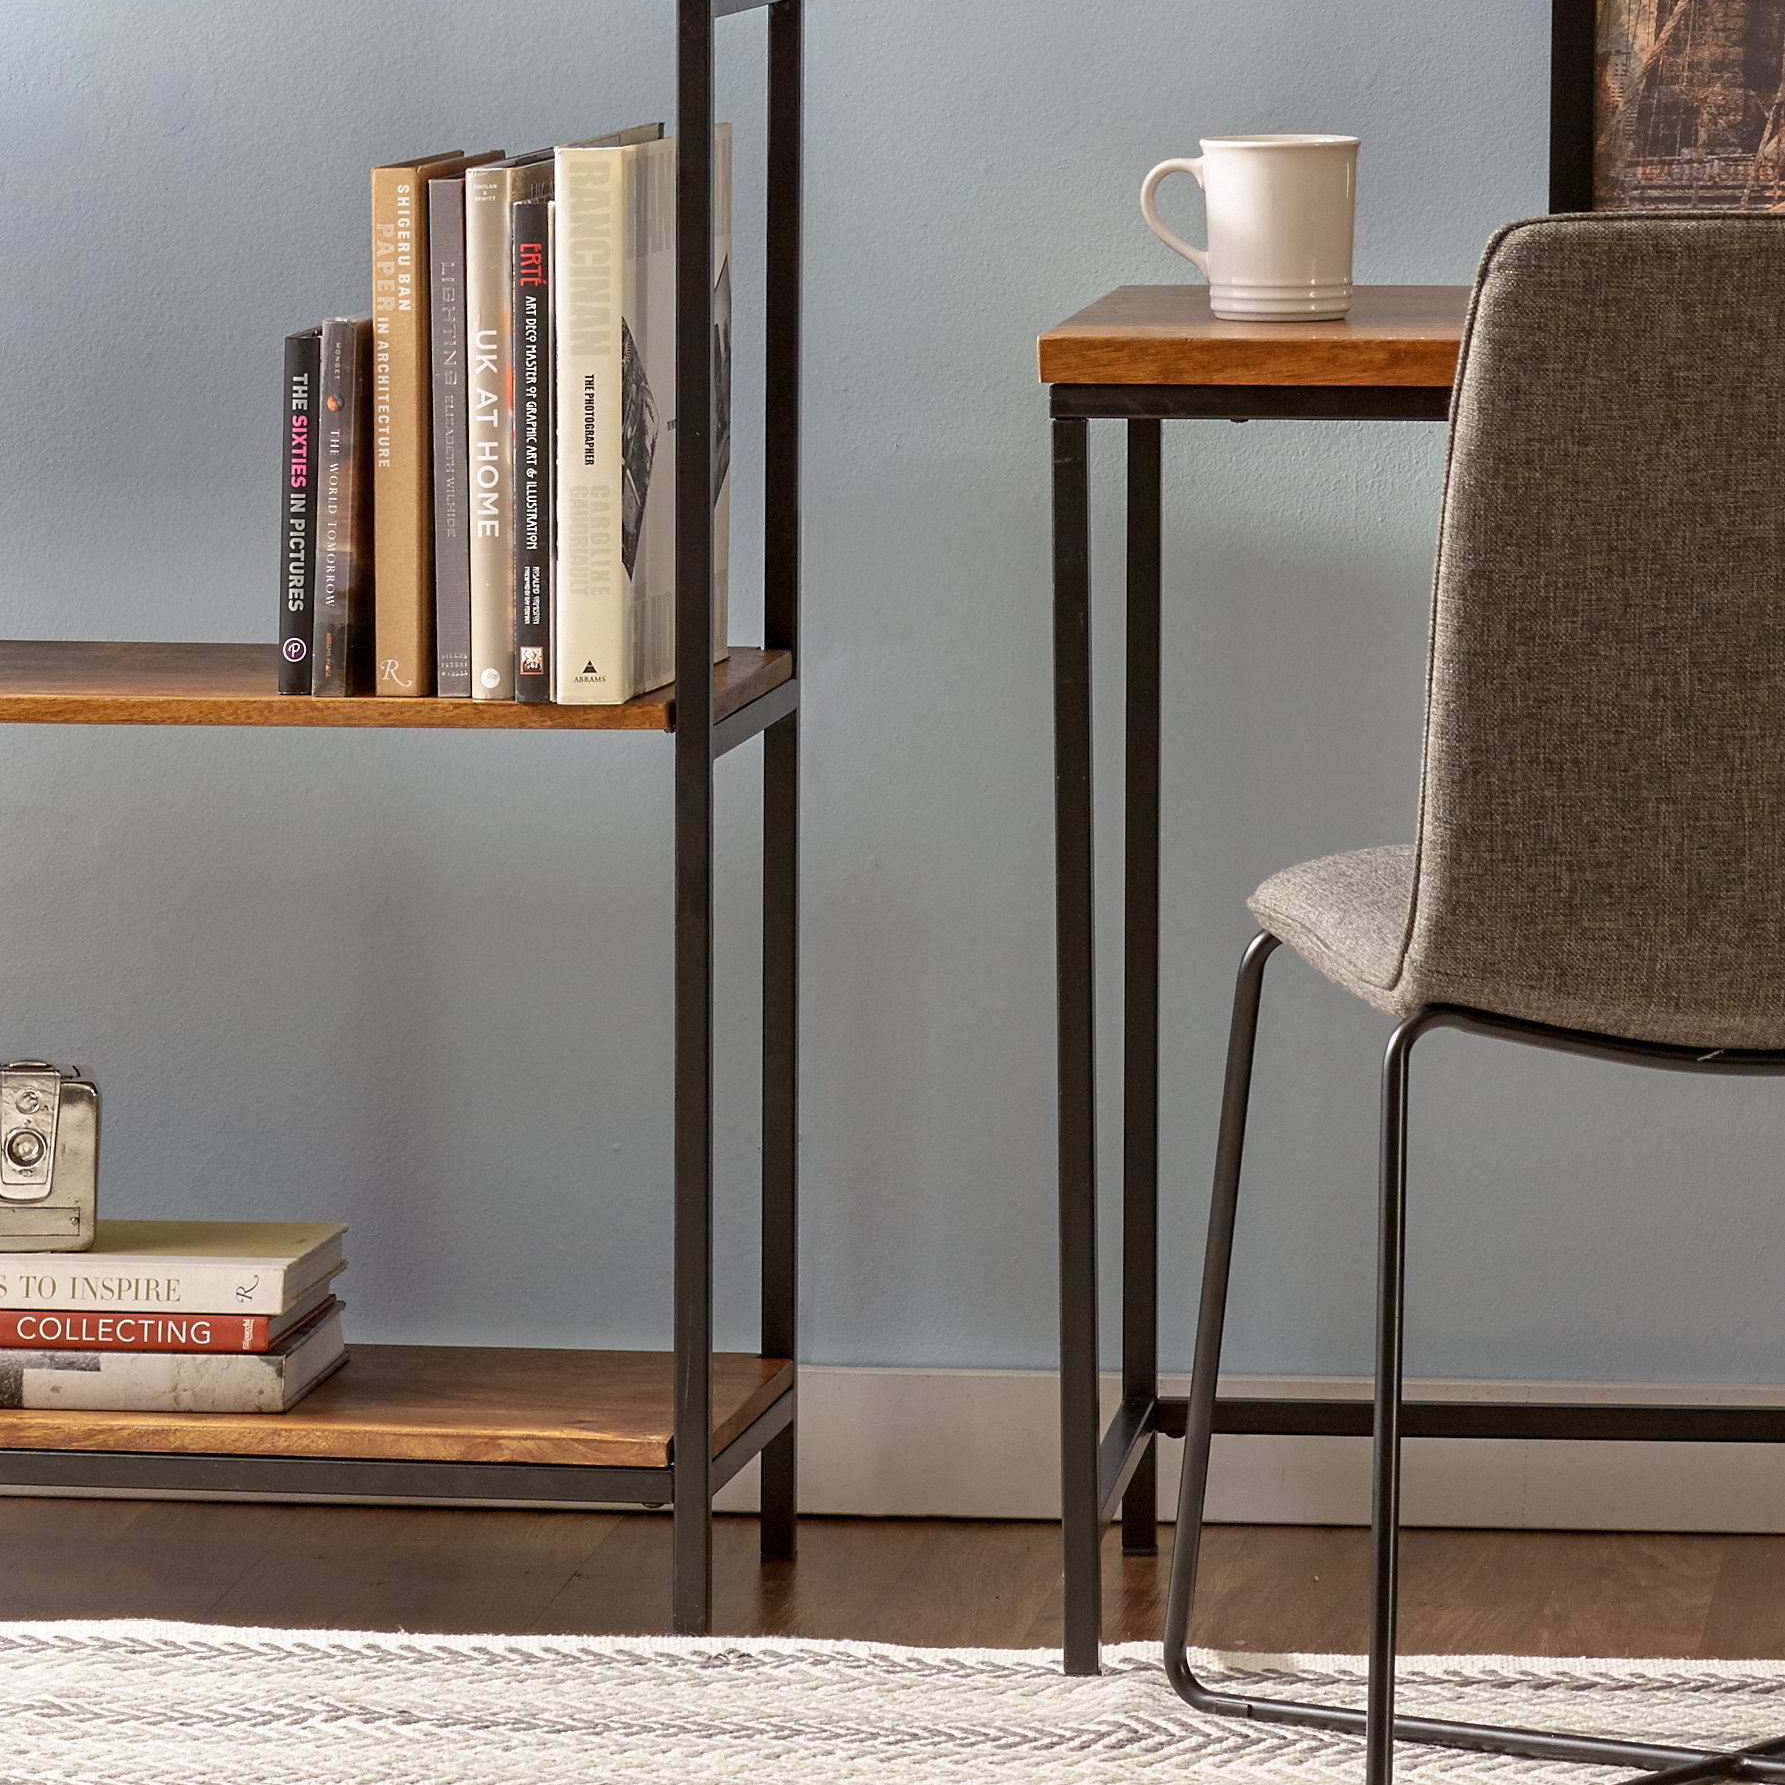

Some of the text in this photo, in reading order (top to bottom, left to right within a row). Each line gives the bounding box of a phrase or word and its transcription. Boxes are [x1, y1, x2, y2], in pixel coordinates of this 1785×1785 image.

[397, 184, 411, 312] SHIGERU BAN
[519, 242, 547, 287] ERTÉ
[567, 161, 612, 357] RANCINAN
[376, 223, 395, 468] PAPER IN ARCHITECTURE
[525, 295, 538, 316] ART
[525, 318, 538, 343] DECO
[440, 261, 457, 539] LIGHTING ELIZABETH WILHIDE
[525, 345, 538, 384] MASTER
[525, 386, 538, 399] OF
[475, 329, 500, 539] UK AT HOME
[525, 401, 538, 443] GRAPHIC
[525, 445, 538, 465] ART
[583, 374, 596, 467] THE PHOTOGRAPHER
[285, 373, 309, 614] THE SIXTIES IN PICTURES
[325, 428, 340, 608] THE WORLD TOMORROW
[525, 481, 538, 550] ILLUSTRATION
[567, 485, 590, 597] GAUDRIAULT
[589, 485, 611, 597] CAROLINE
[20, 1275, 57, 1300] TO
[70, 1276, 182, 1303] INSPIRE
[16, 1316, 212, 1346] COLLECTING
